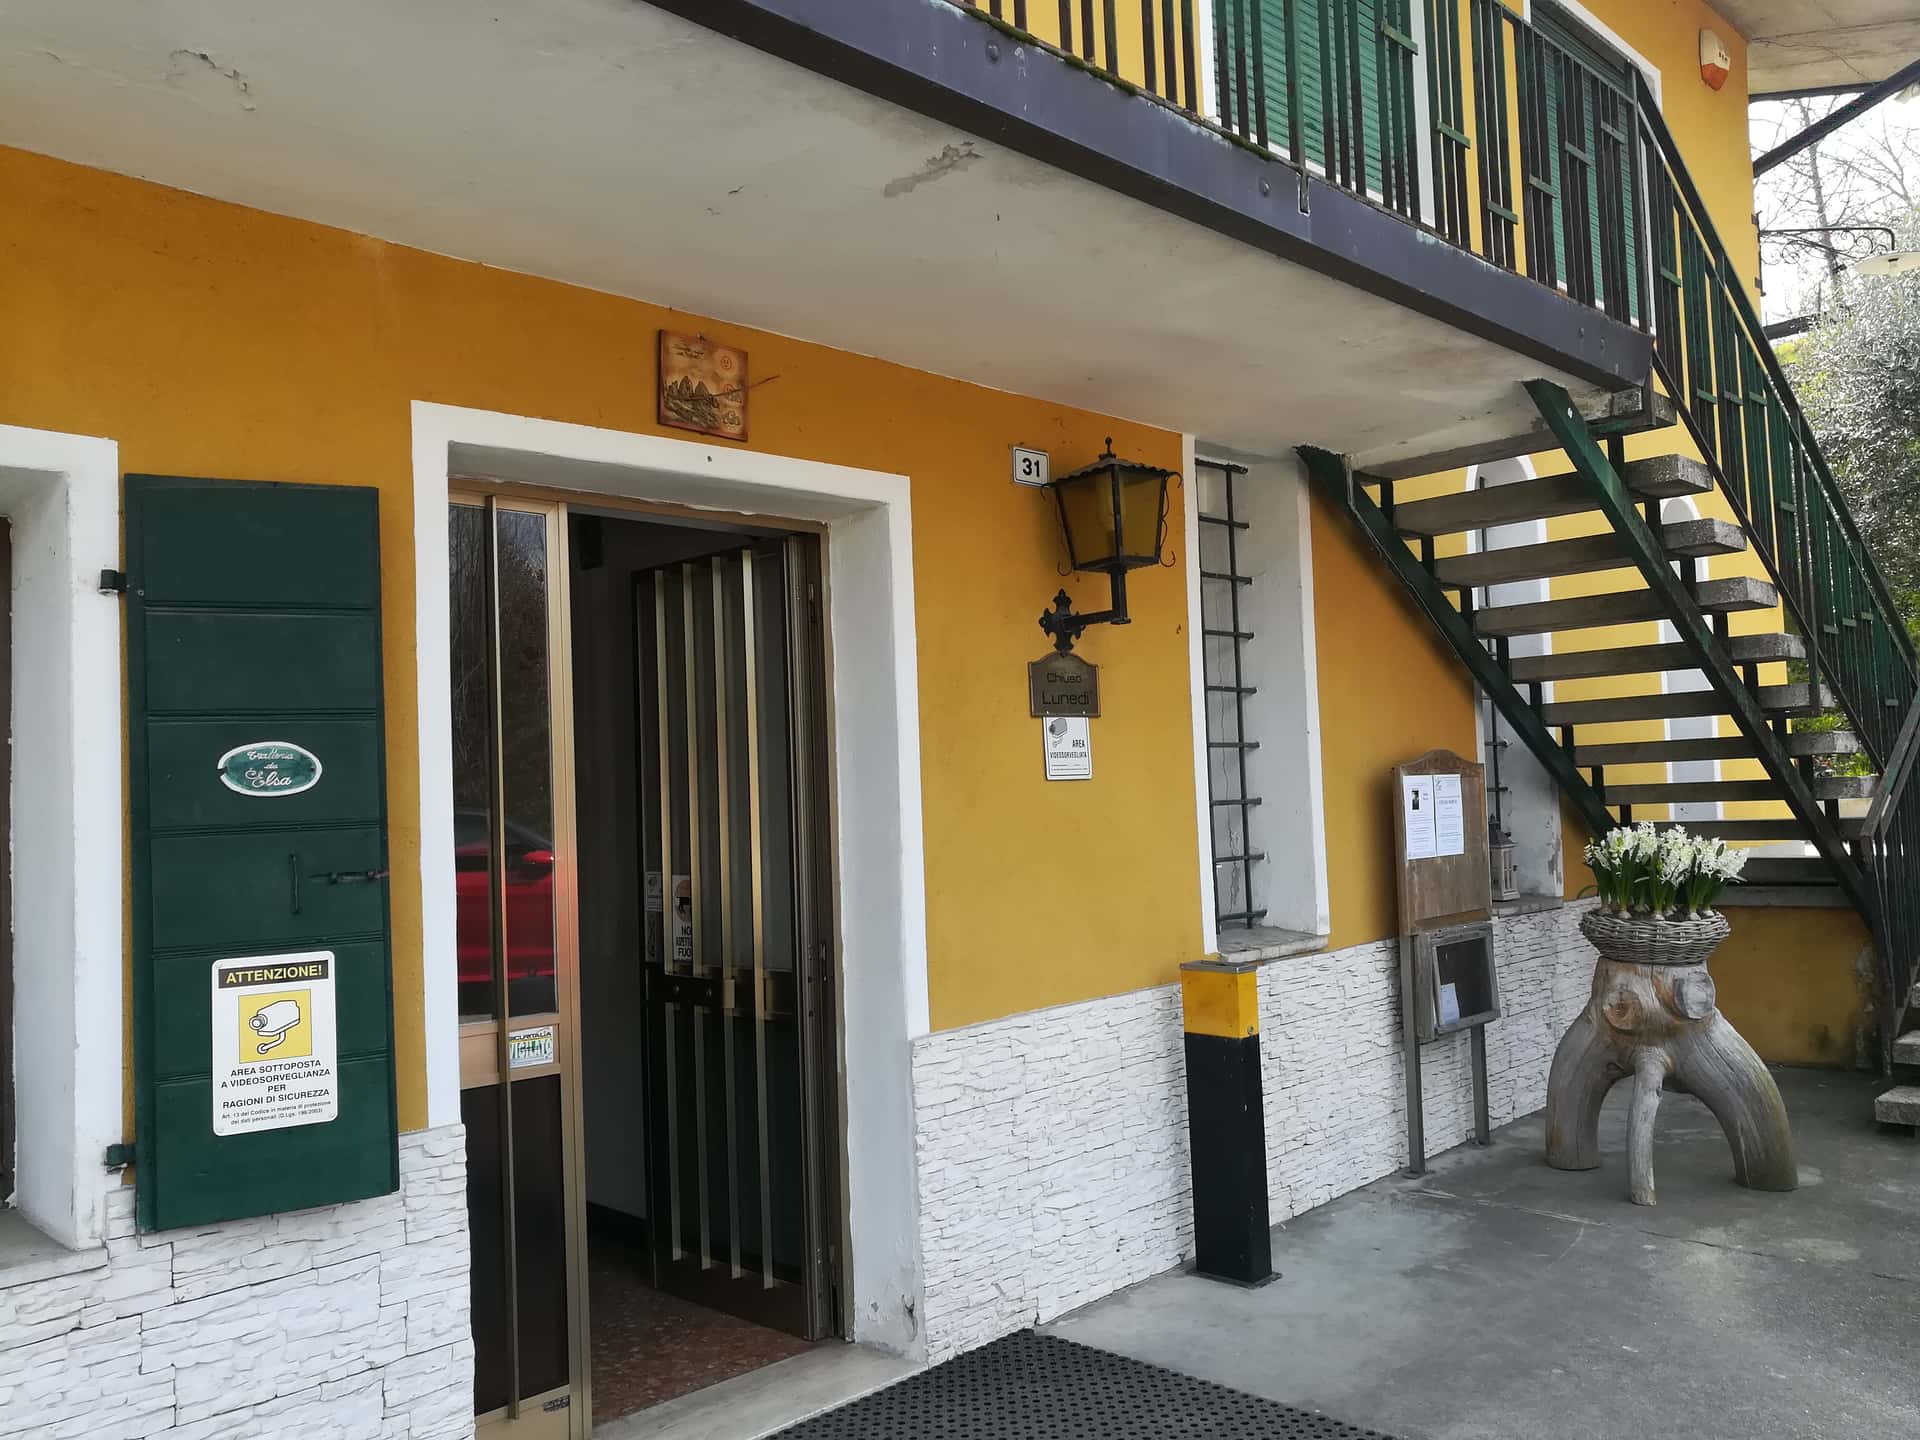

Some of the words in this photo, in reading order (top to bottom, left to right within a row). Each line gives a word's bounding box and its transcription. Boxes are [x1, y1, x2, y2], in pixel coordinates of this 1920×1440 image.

[1022, 457, 1040, 478] 31
[1046, 672, 1082, 684] Chiuso
[1072, 739, 1085, 748] AREA
[245, 768, 293, 788] Elsa
[225, 965, 322, 984] ATTENZIONE!
[230, 1067, 257, 1077] AREA
[259, 1060, 321, 1074] SOTTOPOSTA
[221, 1081, 228, 1089] A
[230, 1069, 331, 1088] VIDEOSORVEGLIANZA
[267, 1084, 286, 1093] PER
[222, 1097, 264, 1109] RAGIONI
[266, 1095, 276, 1104] DI
[278, 1088, 330, 1102] SICUREZZA
